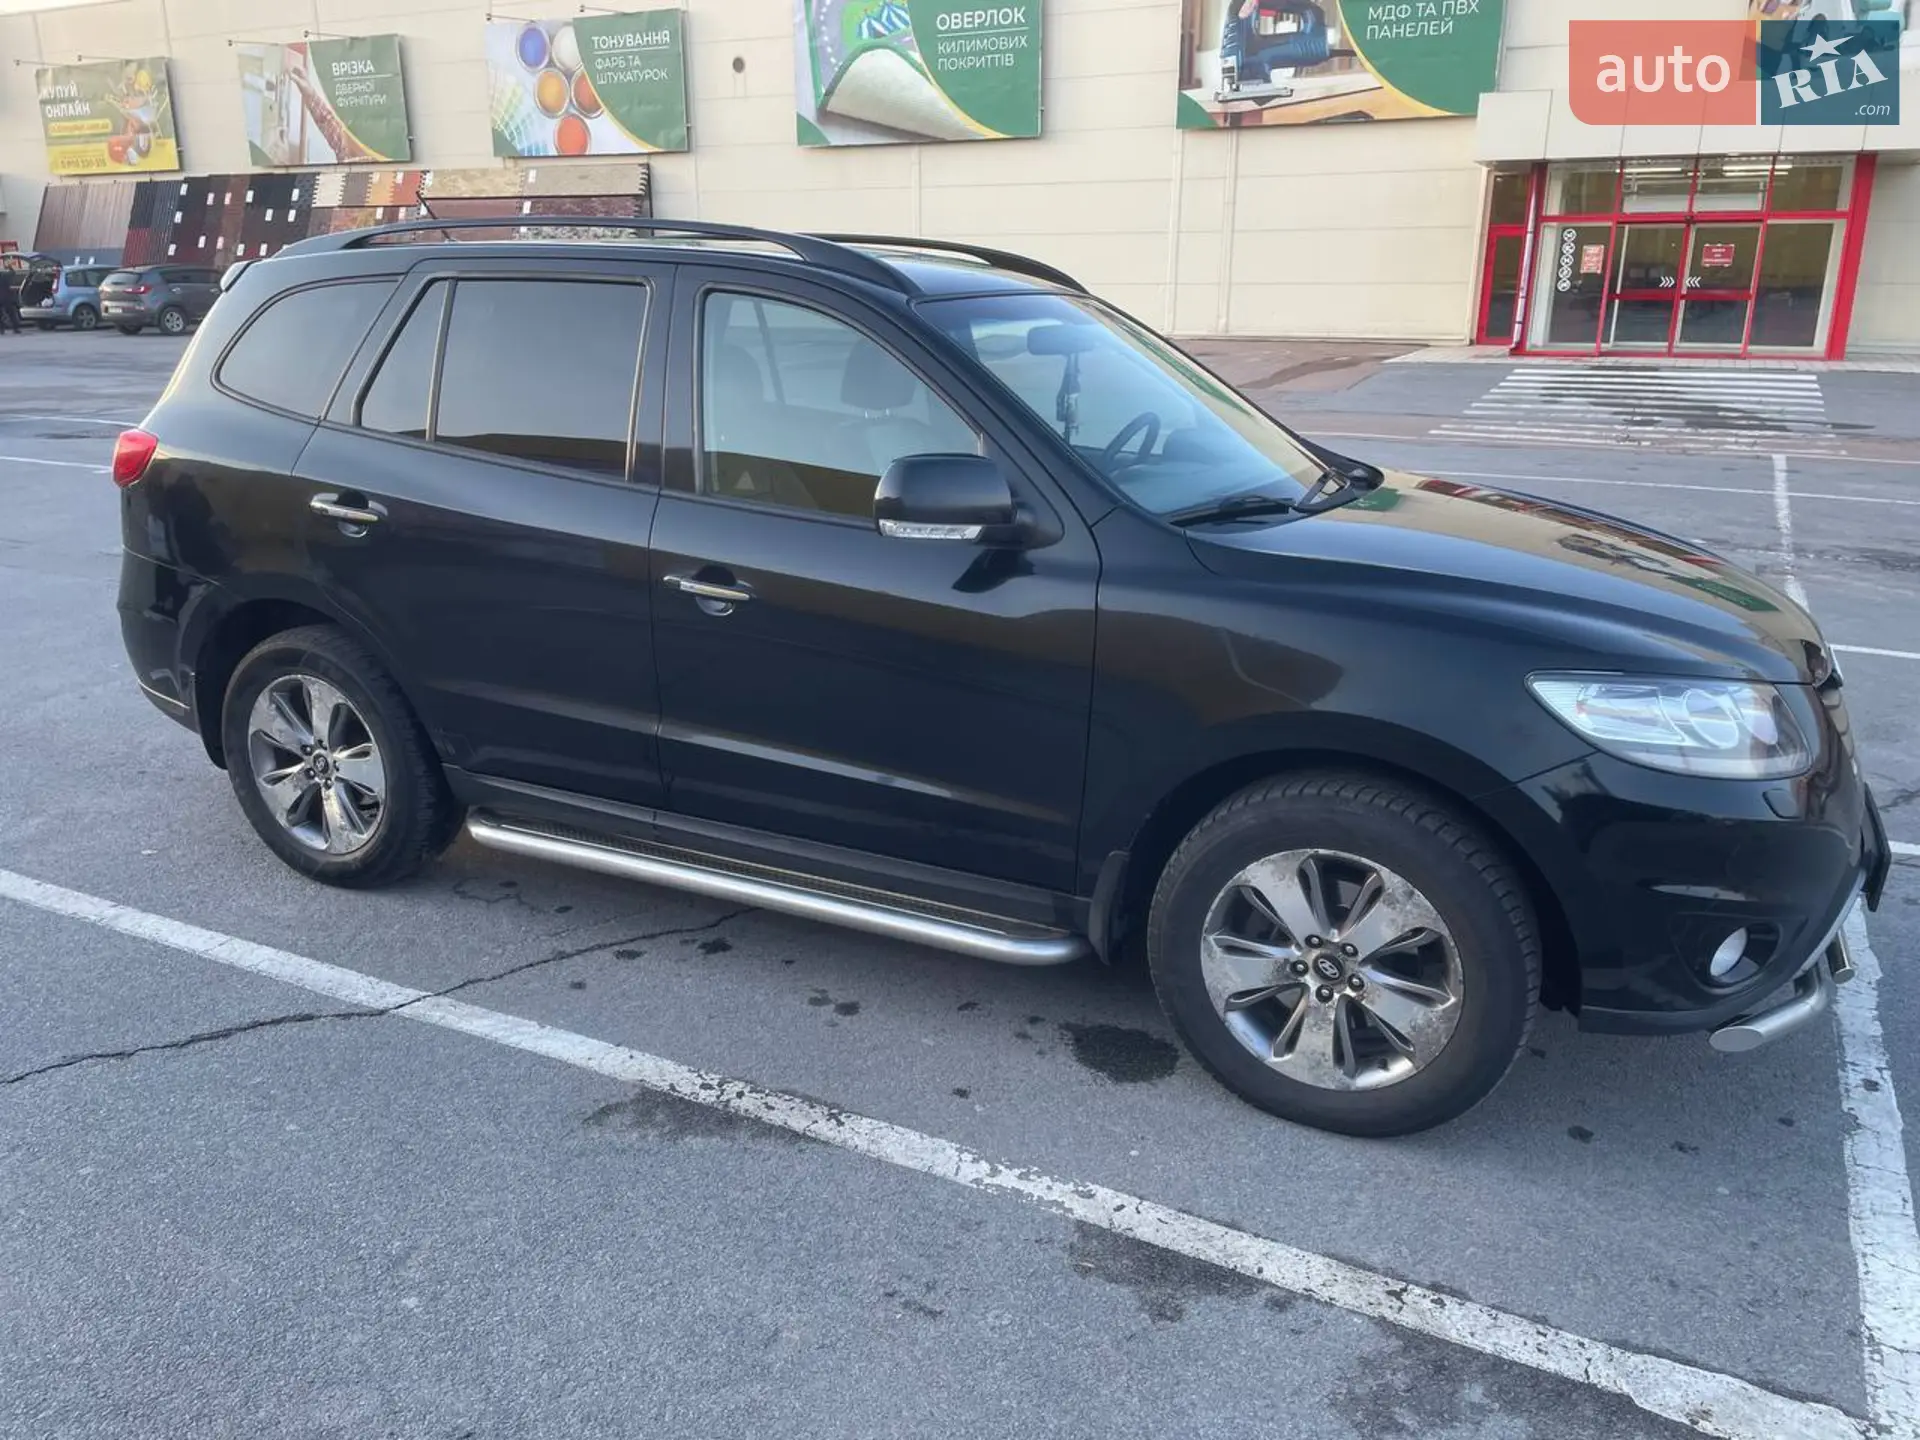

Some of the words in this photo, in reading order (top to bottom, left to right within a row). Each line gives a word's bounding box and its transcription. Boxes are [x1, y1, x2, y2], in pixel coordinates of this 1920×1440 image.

[936, 6, 1026, 31] ОВЕРЛОК
[1368, 4, 1411, 22] МДФ
[1416, 2, 1437, 17] ТА
[1442, 0, 1479, 15] ПВХ
[1366, 17, 1453, 40] ПАНЕЛЕЙ
[592, 30, 670, 49] ТОНУВАННЯ
[938, 36, 1028, 55] КИЛИМОВИХ
[332, 60, 375, 76] ВРІЗКА
[595, 56, 626, 70] ФАРБ
[628, 55, 641, 67] ТА
[938, 53, 1014, 71] ПОКРИТТІВ
[596, 68, 669, 85] ШТУКАТУРОК
[46, 100, 91, 117] ОНЛАЙН
